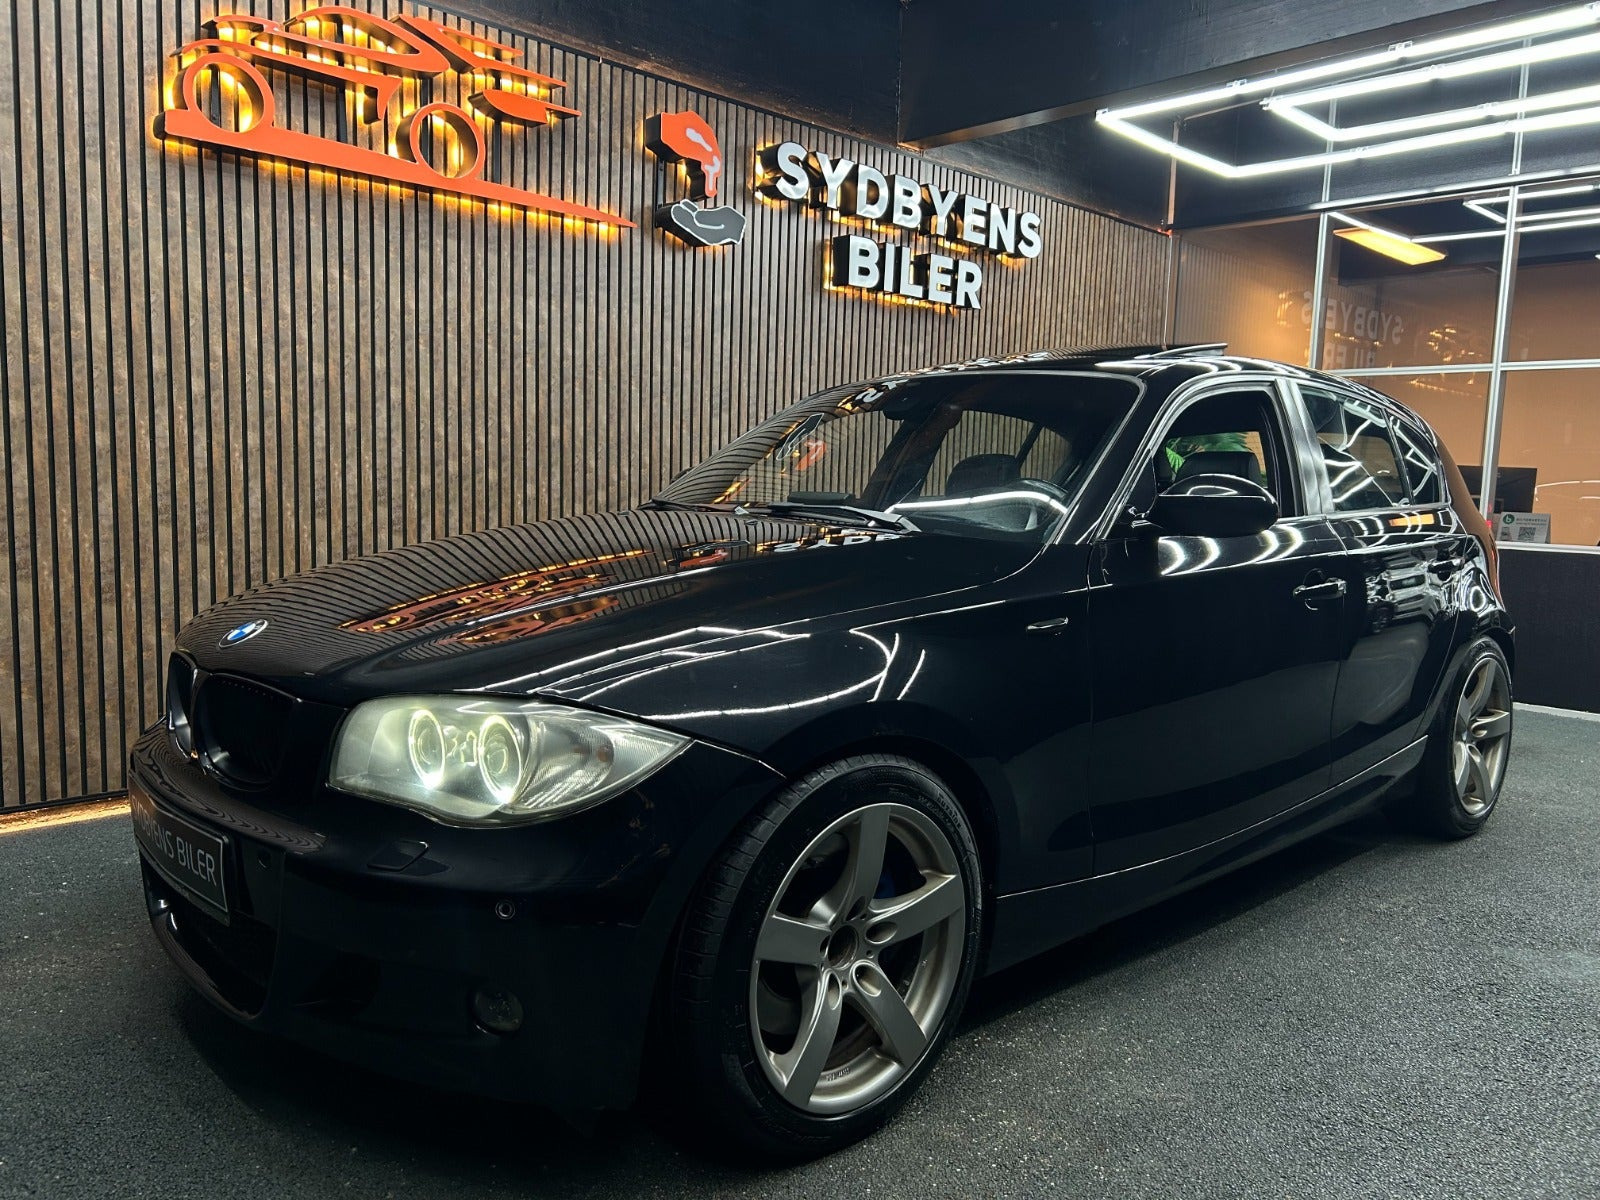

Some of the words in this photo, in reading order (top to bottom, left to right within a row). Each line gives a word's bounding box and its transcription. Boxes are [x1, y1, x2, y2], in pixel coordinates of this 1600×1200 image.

[775, 141, 1042, 258] SYDBYENS
[848, 234, 982, 310] BILER
[176, 835, 217, 887] BILER
